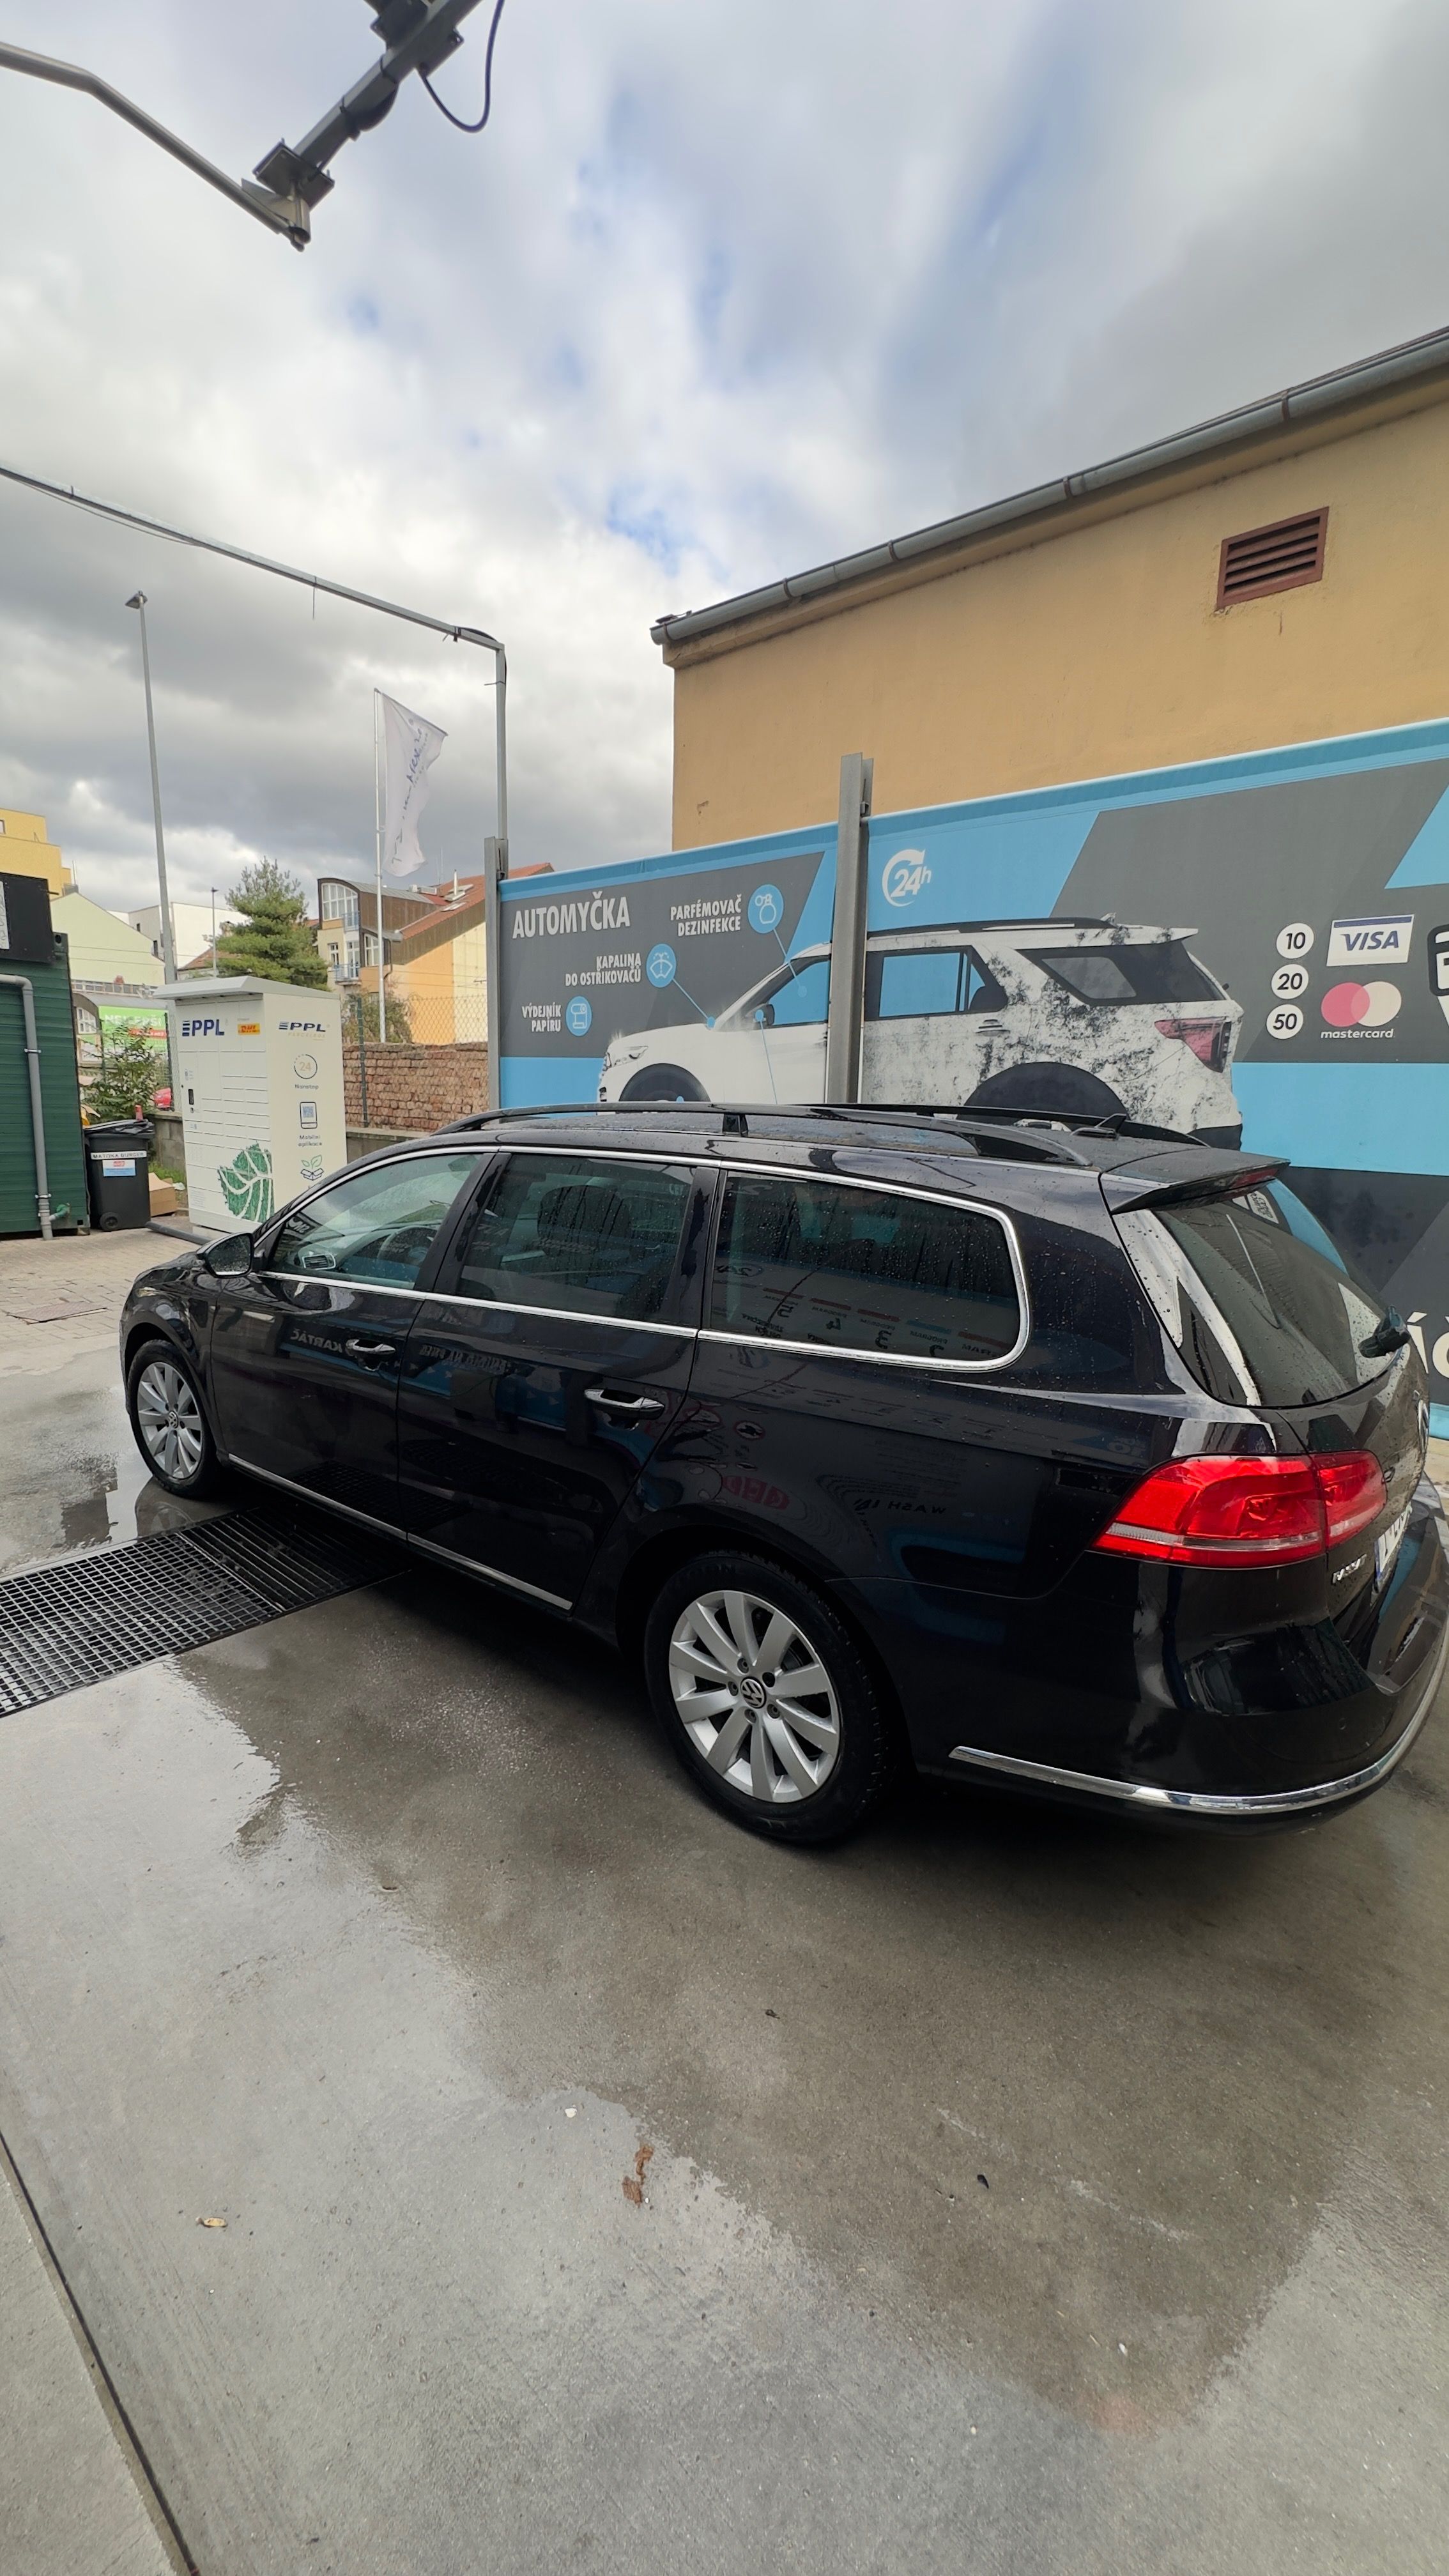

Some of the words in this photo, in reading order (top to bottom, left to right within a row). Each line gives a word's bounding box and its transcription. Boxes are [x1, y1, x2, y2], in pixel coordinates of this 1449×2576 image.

[891, 866, 932, 897] 24h
[512, 891, 631, 939] AUTOMYČKA
[670, 894, 742, 921] PARFÉMOVAČ
[677, 916, 741, 937] DEZINFEKCE
[1285, 931, 1306, 949] 10
[1340, 930, 1399, 951] VISA
[596, 953, 641, 970] KAPALINA
[565, 974, 578, 986] DO
[579, 964, 641, 986] OSTŘIKOVAČŮ
[1277, 972, 1303, 990] 20
[521, 1002, 562, 1019] VÝDEJNÍK
[192, 1018, 225, 1036] PPL
[289, 1022, 326, 1032] PPL
[531, 1018, 561, 1032] PAPÍRU
[1273, 1013, 1297, 1030] 50
[1321, 1028, 1395, 1039] mastercard
[299, 1062, 312, 1071] 24
